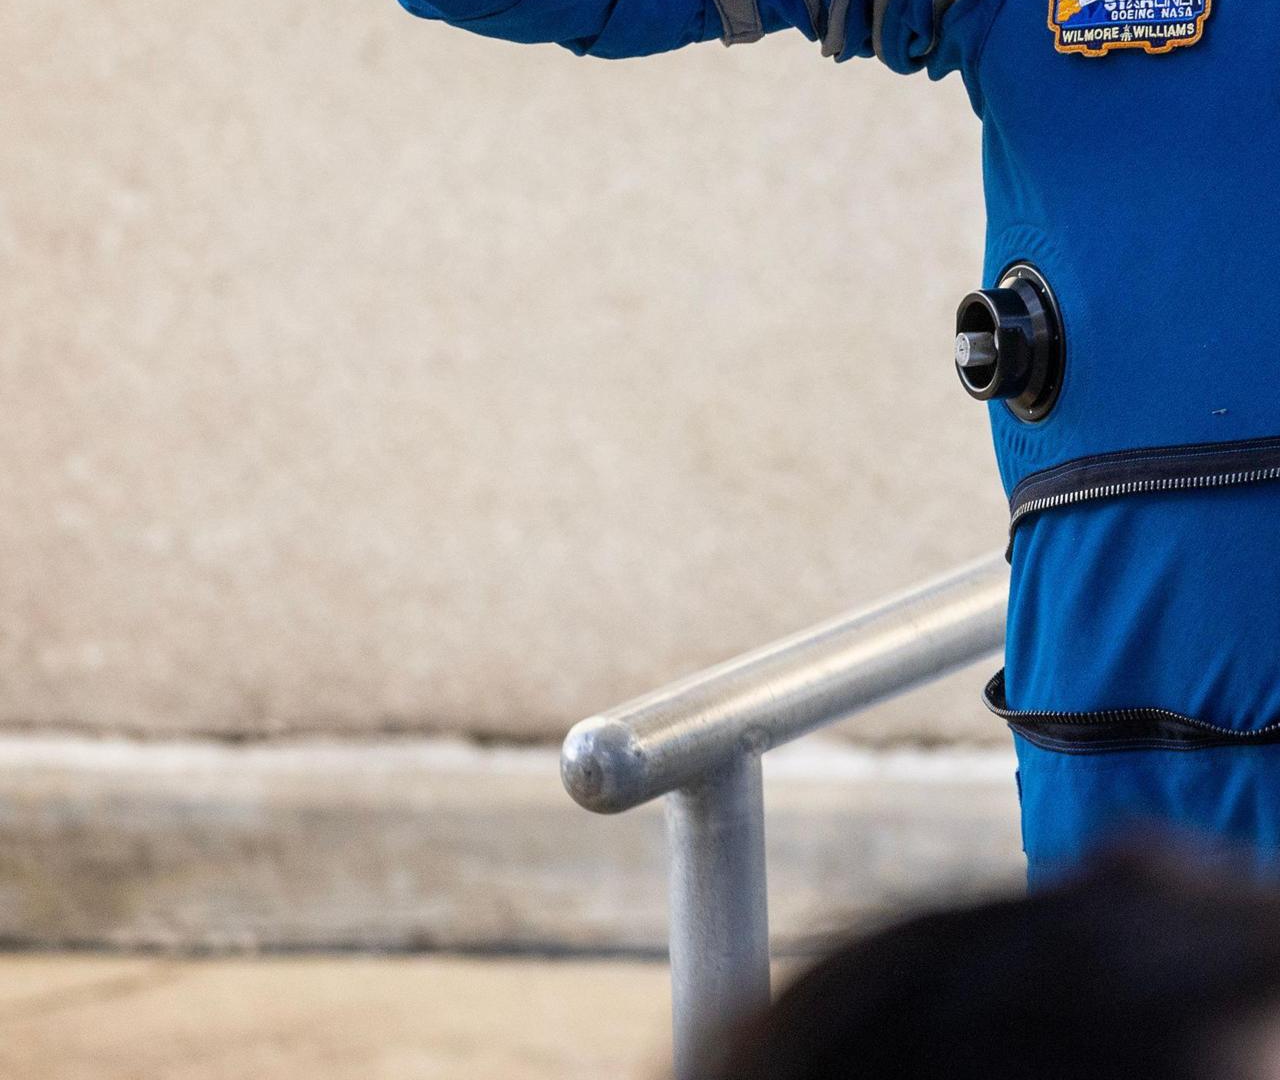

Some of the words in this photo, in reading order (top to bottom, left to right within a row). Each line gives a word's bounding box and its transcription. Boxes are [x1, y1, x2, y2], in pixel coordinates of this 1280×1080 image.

[1161, 6, 1193, 18] NASA
[1062, 25, 1120, 43] WILMORE
[1132, 22, 1195, 38] WILLIAMS
